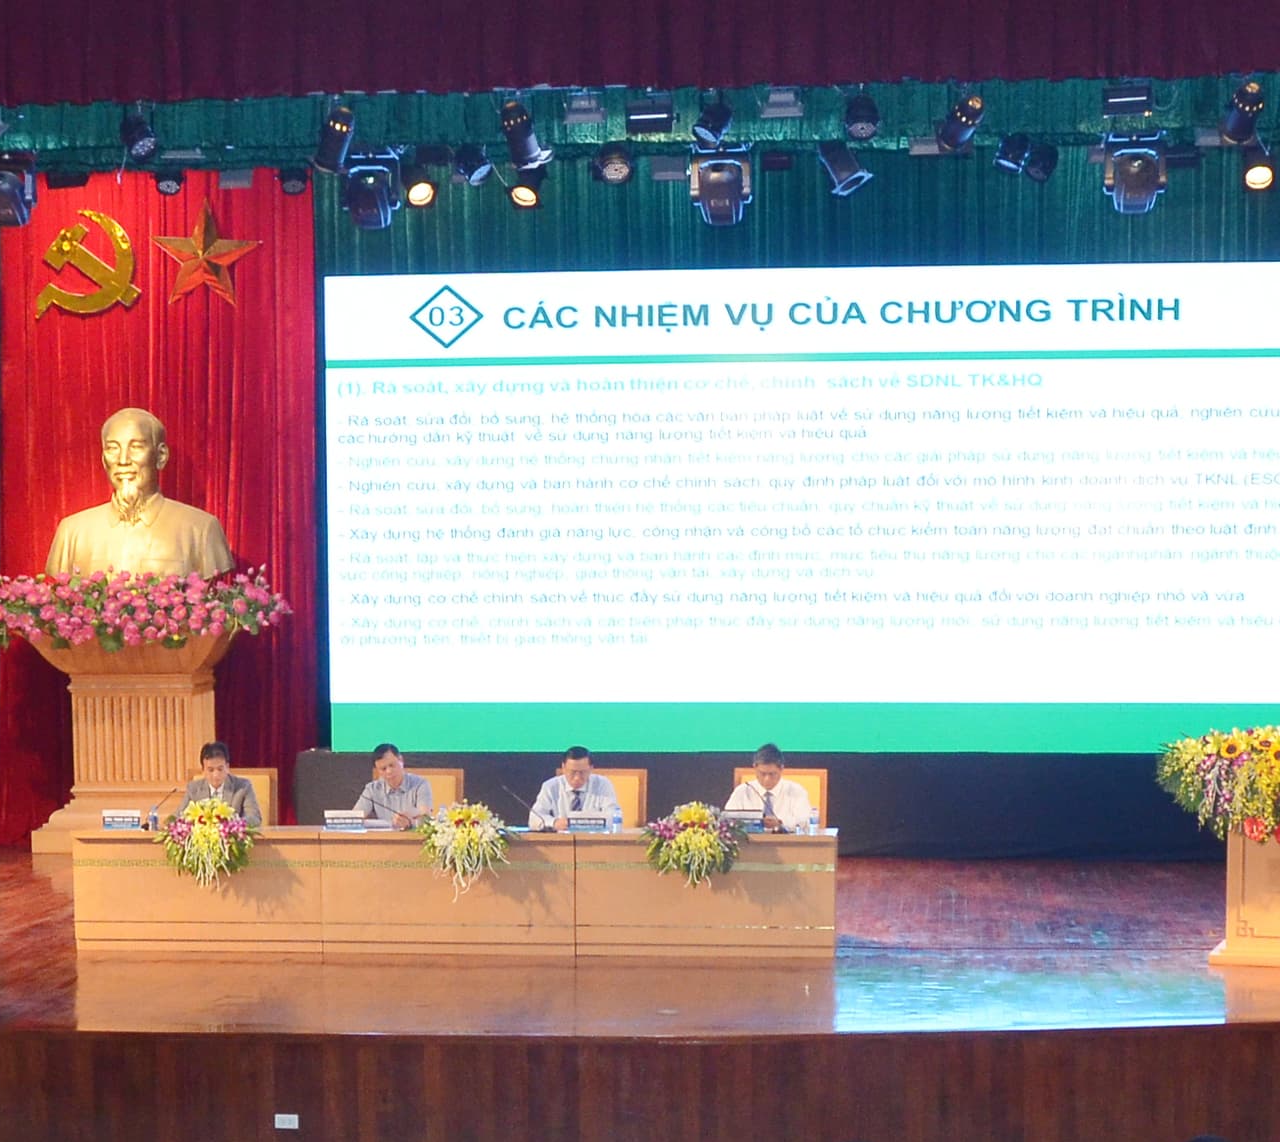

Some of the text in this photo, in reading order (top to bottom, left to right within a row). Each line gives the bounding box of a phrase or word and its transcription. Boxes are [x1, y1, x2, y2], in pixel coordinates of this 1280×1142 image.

[429, 291, 1181, 333] 03 CÁC NHIỆM VỤ CỦA CHƯƠNG TRÌNH
